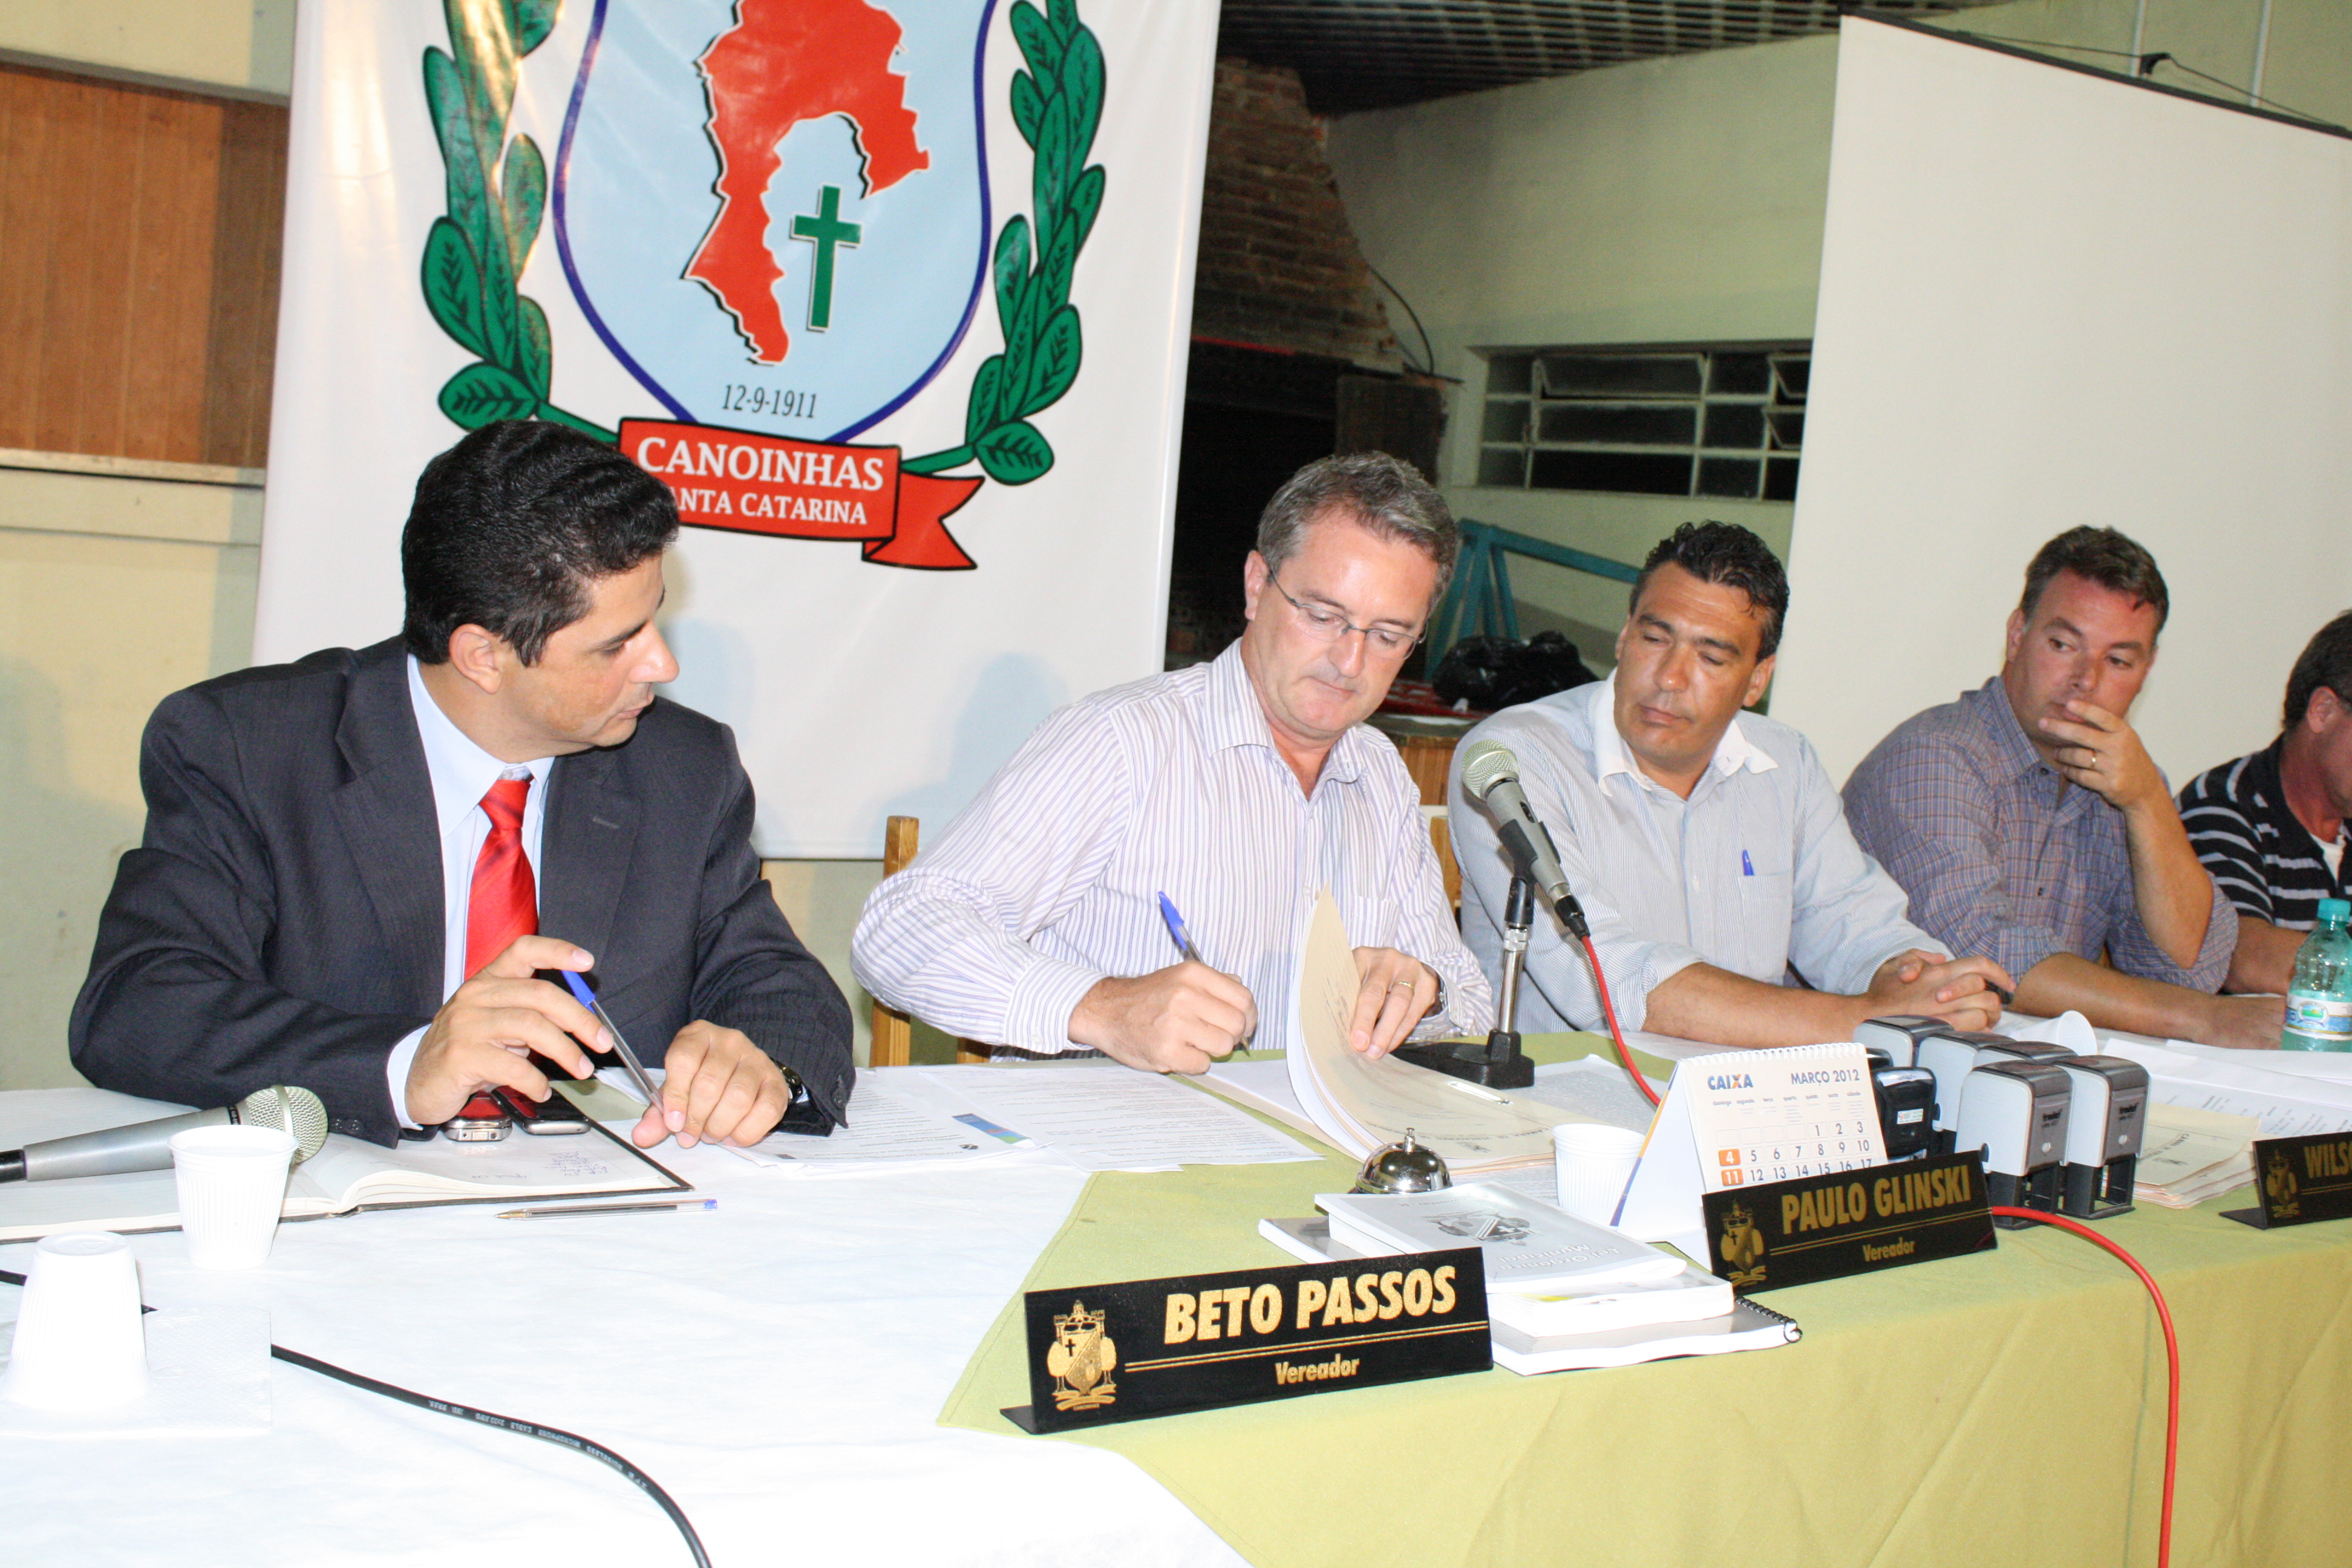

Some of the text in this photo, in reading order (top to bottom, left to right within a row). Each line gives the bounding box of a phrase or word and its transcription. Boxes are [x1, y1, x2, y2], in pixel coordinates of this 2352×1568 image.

[722, 384, 817, 419] 12-9-1911
[637, 436, 884, 491] CANOINHAS
[740, 492, 867, 525] CATARINA
[1707, 1069, 1860, 1090] CAIXA MARÇO 2012
[1815, 1121, 1864, 1136] 1 2 3
[1726, 1139, 1870, 1164] 4 5 6 7 8 9 10
[2304, 1140, 2352, 1179] WILS
[1725, 1158, 1872, 1184] 11 12 13 14 15 16 17
[1781, 1165, 1971, 1235] PAULO GLINSKI
[1497, 1244, 1592, 1264] Municipal
[1589, 1247, 1622, 1258] Lei
[1862, 1238, 1915, 1263] Vereador
[1164, 1265, 1456, 1345] BETO PASSOS
[1275, 1354, 1361, 1386] Vereador
